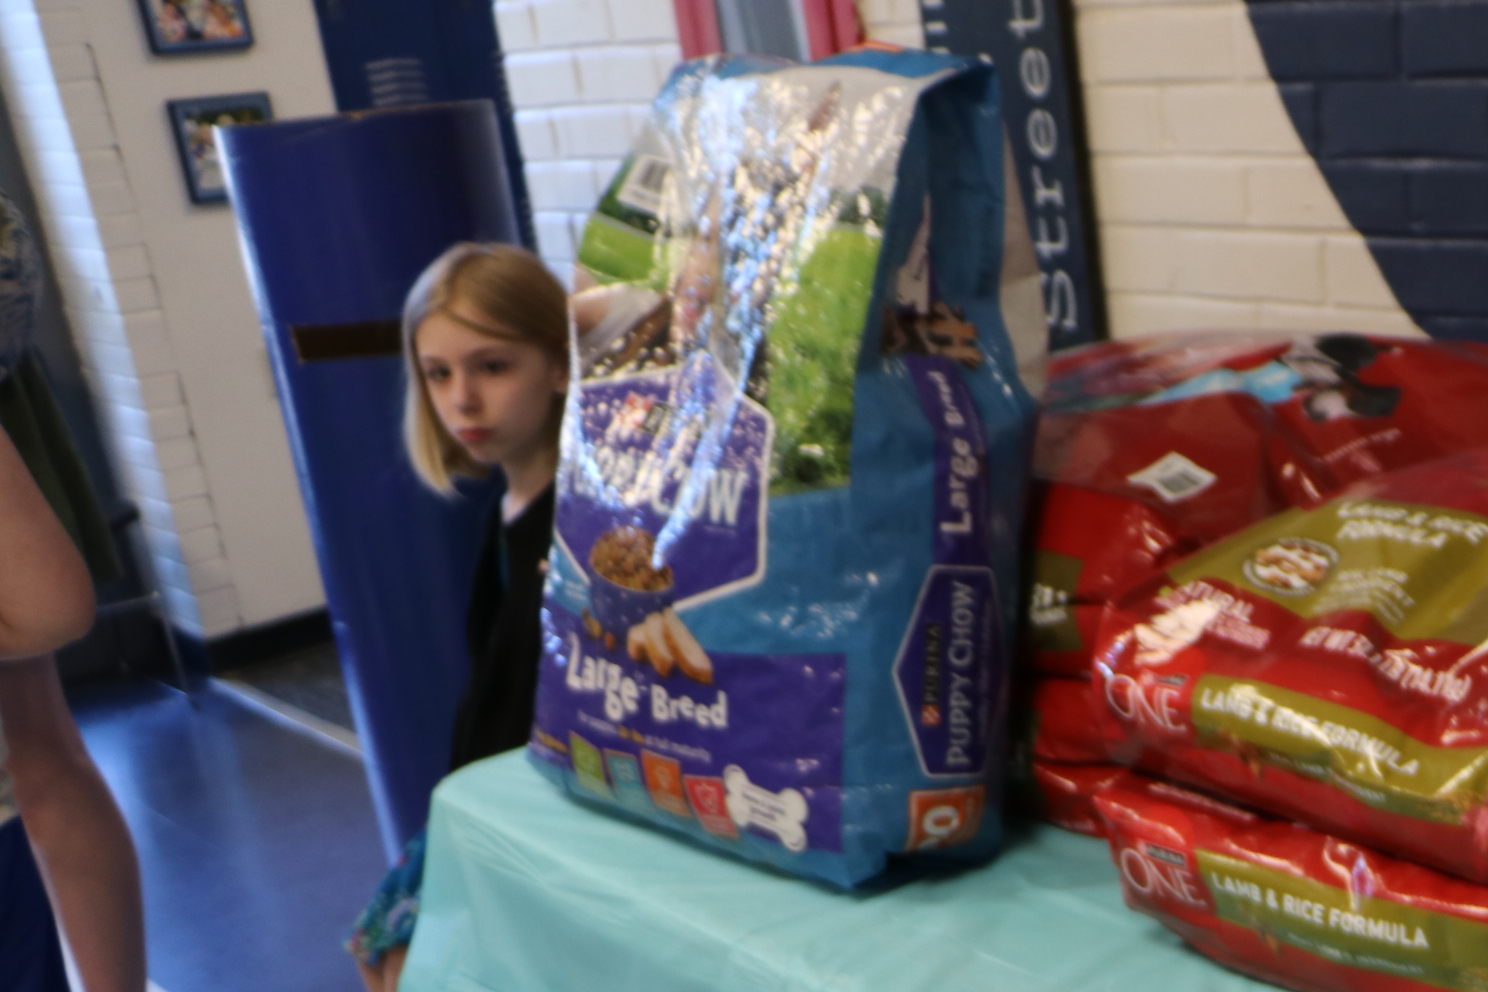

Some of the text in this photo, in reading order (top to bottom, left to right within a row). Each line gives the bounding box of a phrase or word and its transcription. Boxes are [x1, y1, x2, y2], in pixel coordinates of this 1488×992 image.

[939, 437, 980, 533] Large
[565, 631, 729, 729] Large Breed
[946, 580, 976, 766] PUPPY CHOW
[1106, 672, 1188, 734] ONE
[1318, 718, 1421, 776] FORMULA
[1119, 847, 1208, 907] ONE
[1210, 871, 1263, 903] LAMB
[1264, 887, 1280, 910] &
[1281, 892, 1325, 927] RICE
[1327, 907, 1430, 949] FORMULA
